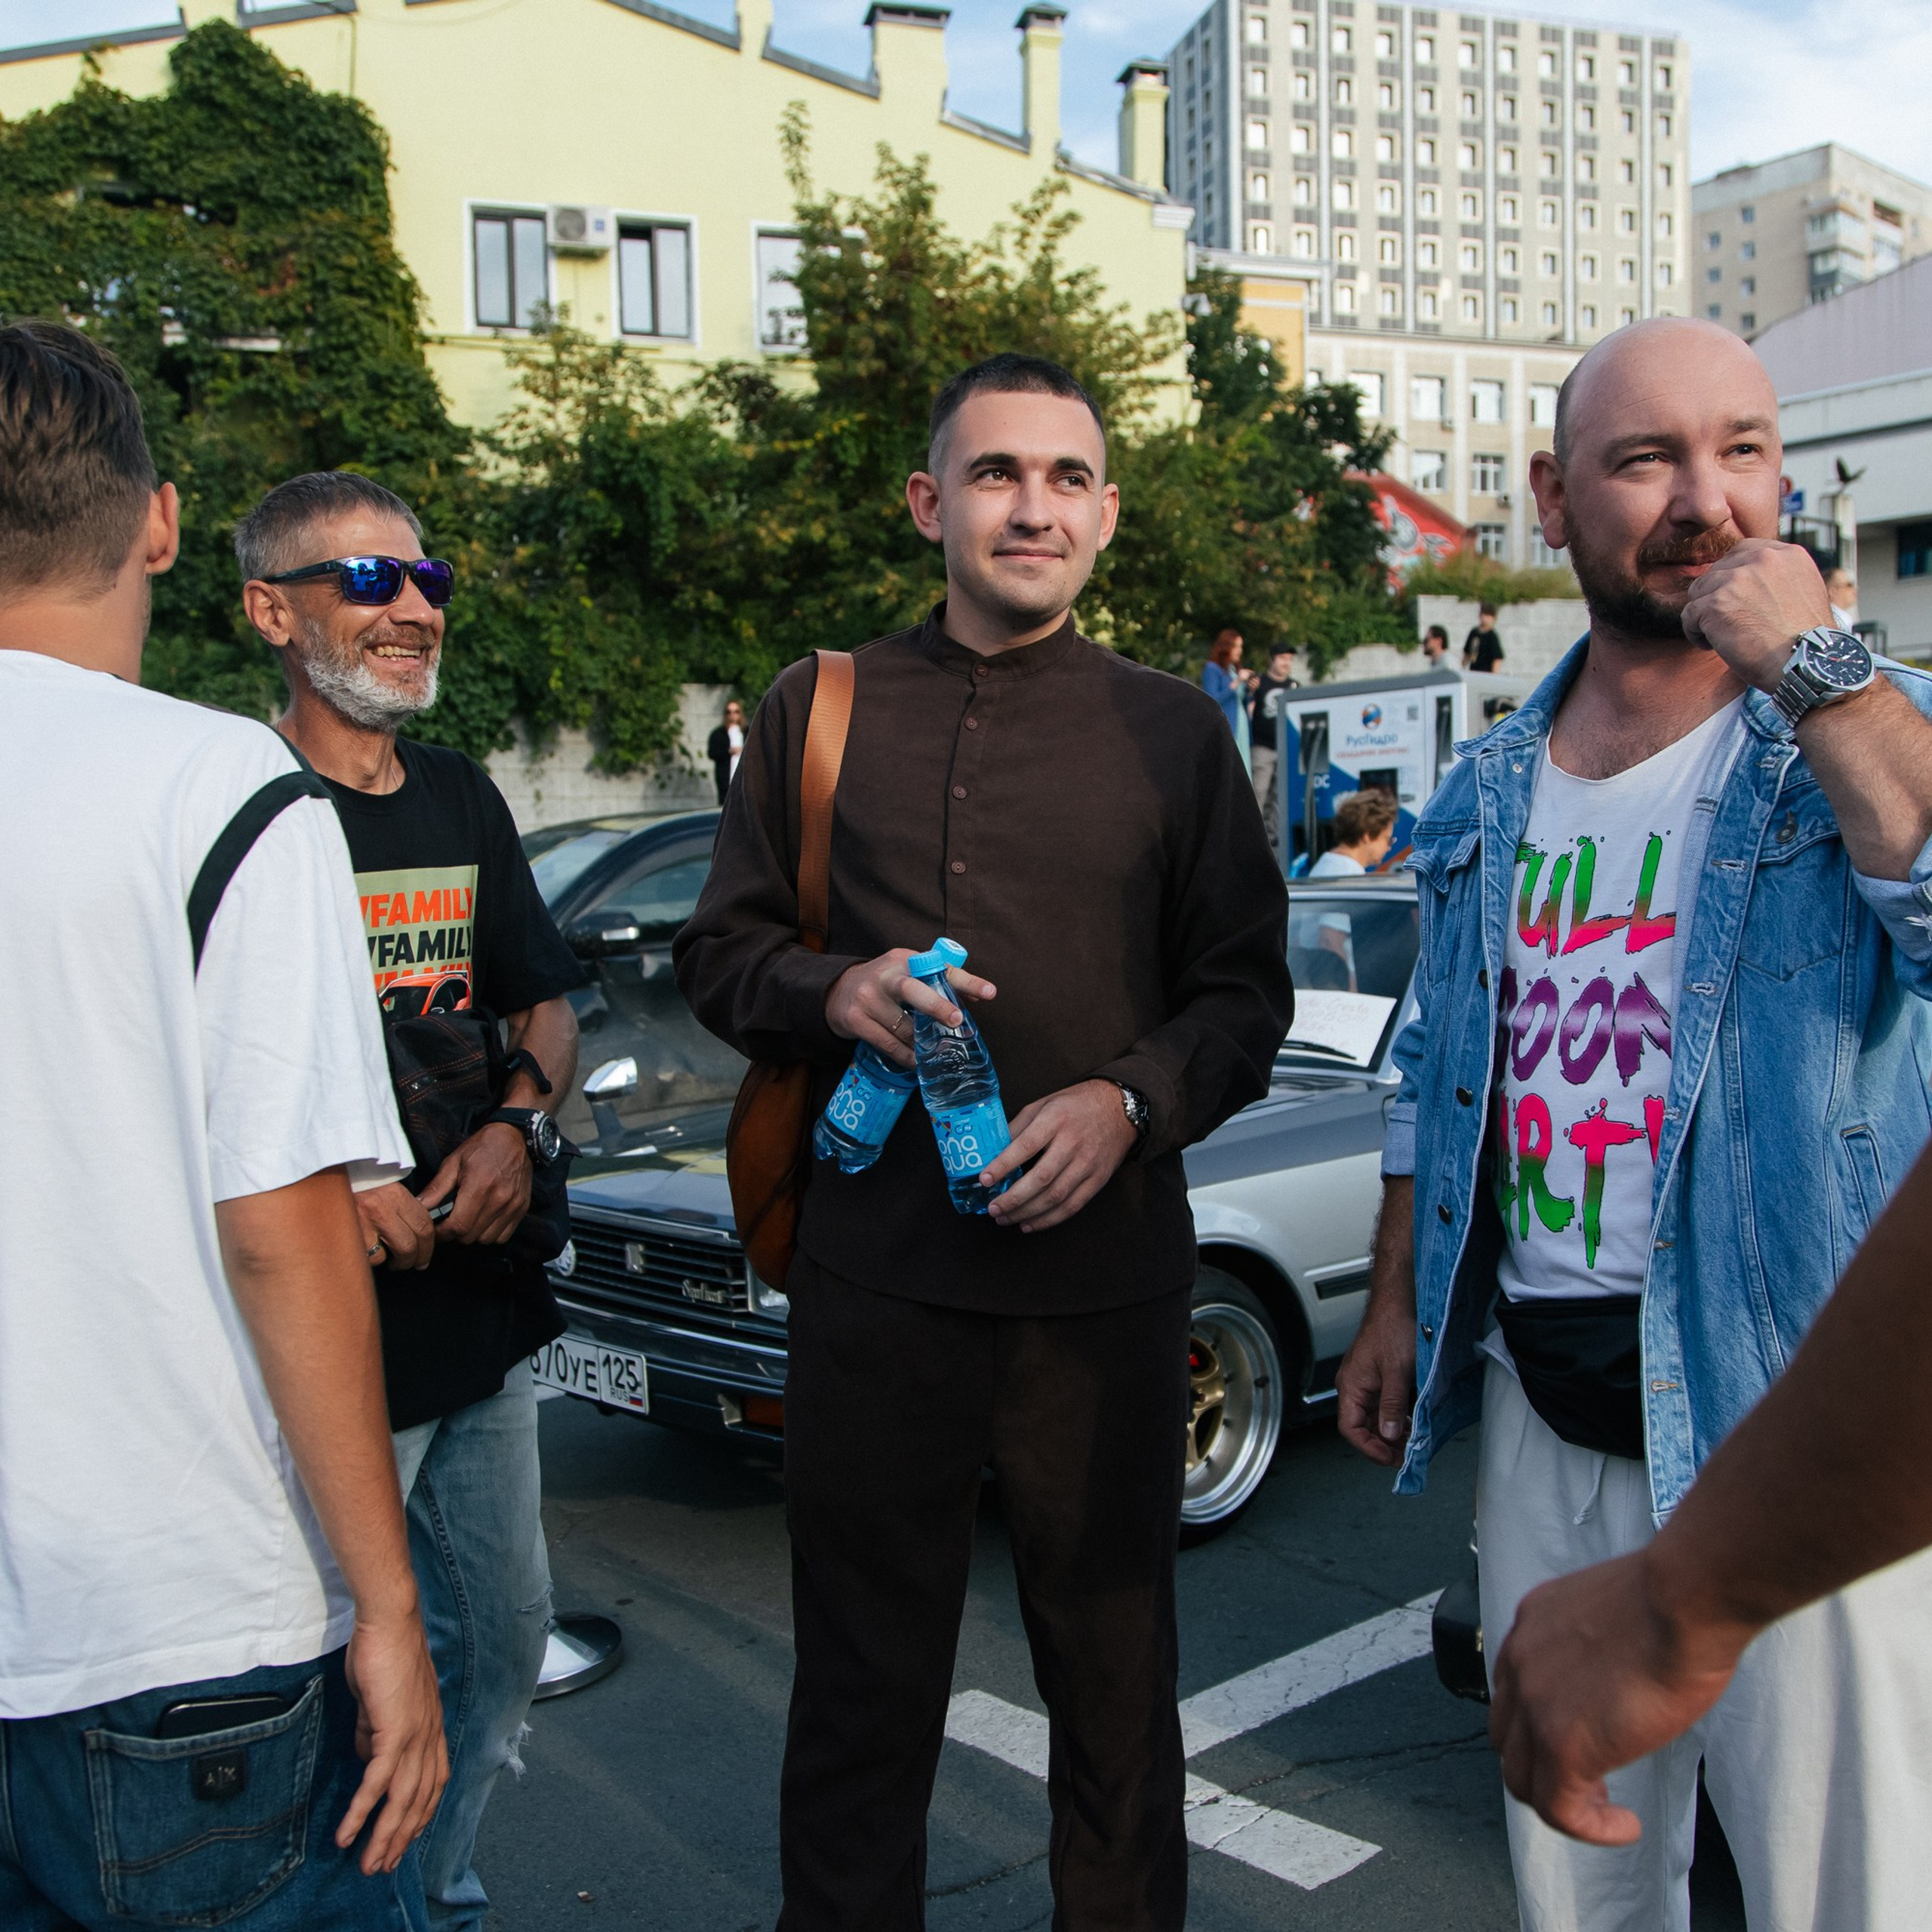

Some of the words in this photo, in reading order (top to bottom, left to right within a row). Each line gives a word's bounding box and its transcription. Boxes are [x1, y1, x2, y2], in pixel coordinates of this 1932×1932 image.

[1517, 832, 1677, 958] ULL
[602, 1353, 639, 1392] 125
[611, 1388, 629, 1402] RUS
